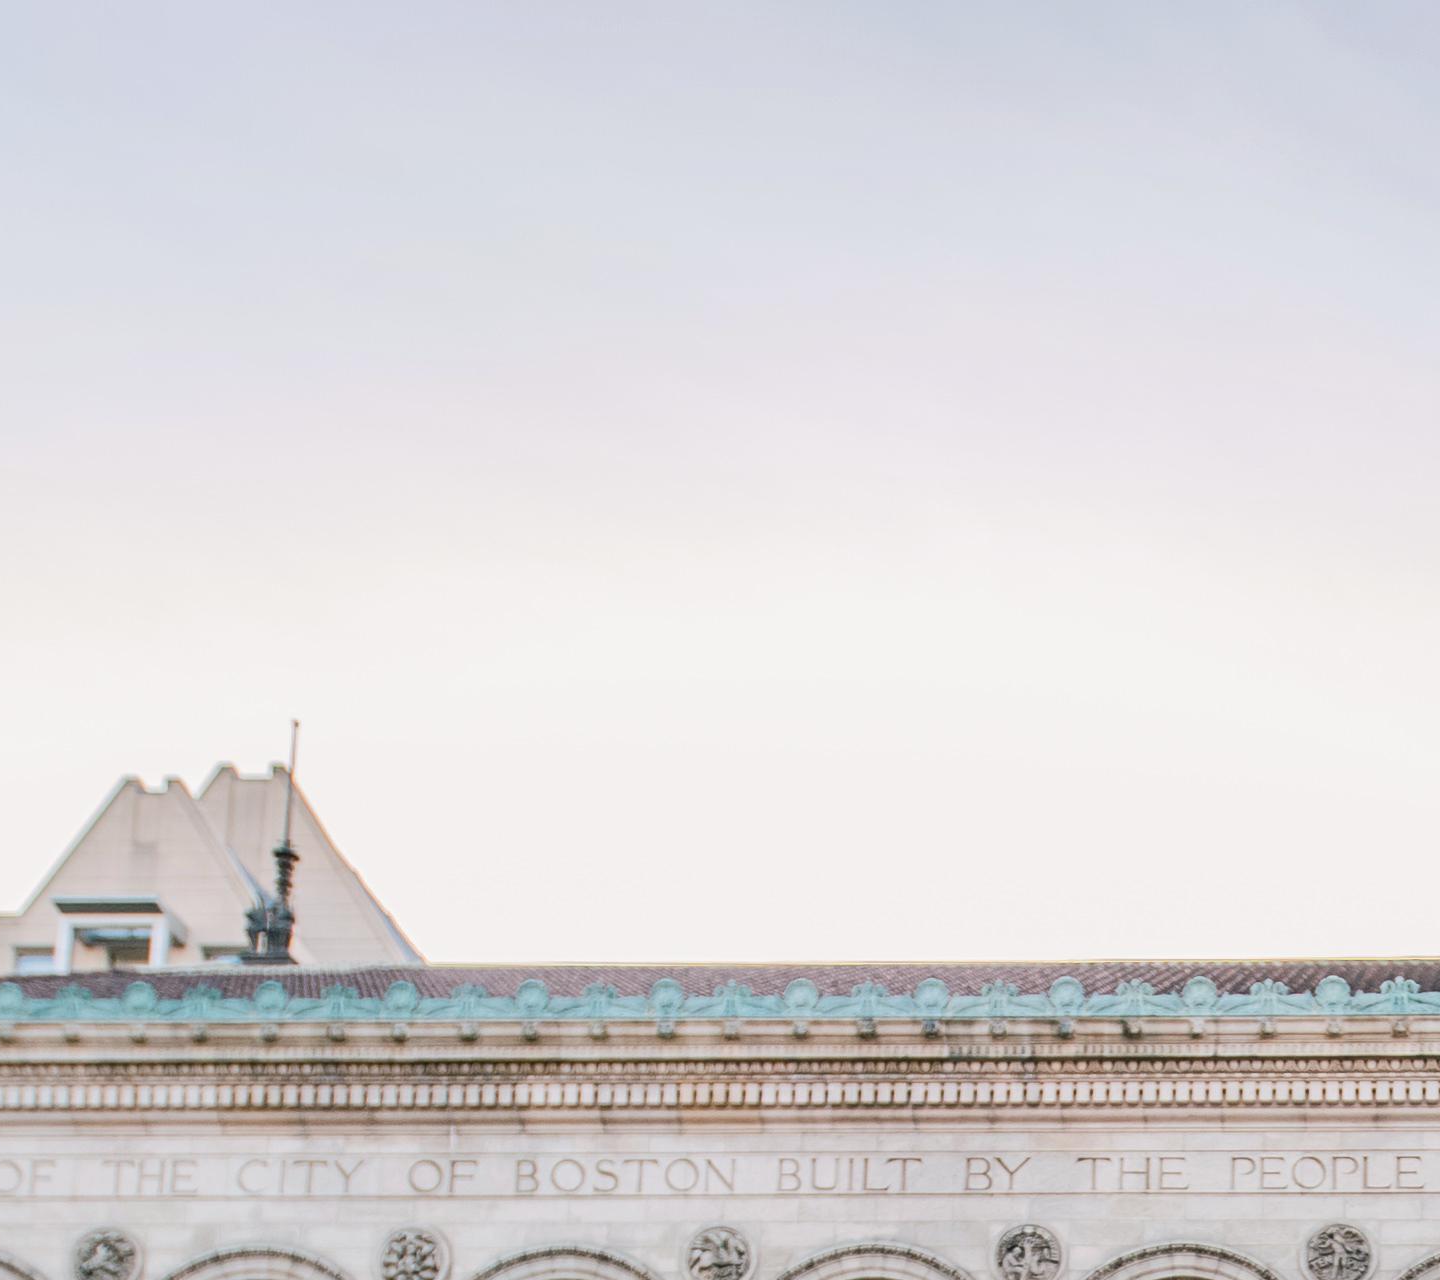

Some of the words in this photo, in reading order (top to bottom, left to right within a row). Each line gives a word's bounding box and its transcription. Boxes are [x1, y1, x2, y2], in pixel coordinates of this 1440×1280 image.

[103, 1159, 199, 1196] THE
[237, 1158, 366, 1195] CITY
[407, 1158, 478, 1194] OF
[515, 1157, 737, 1194] BOSTON
[777, 1156, 923, 1192] BUILT
[963, 1156, 1032, 1191] BY
[1077, 1156, 1189, 1191] THE
[1230, 1155, 1425, 1190] PEOPLE
